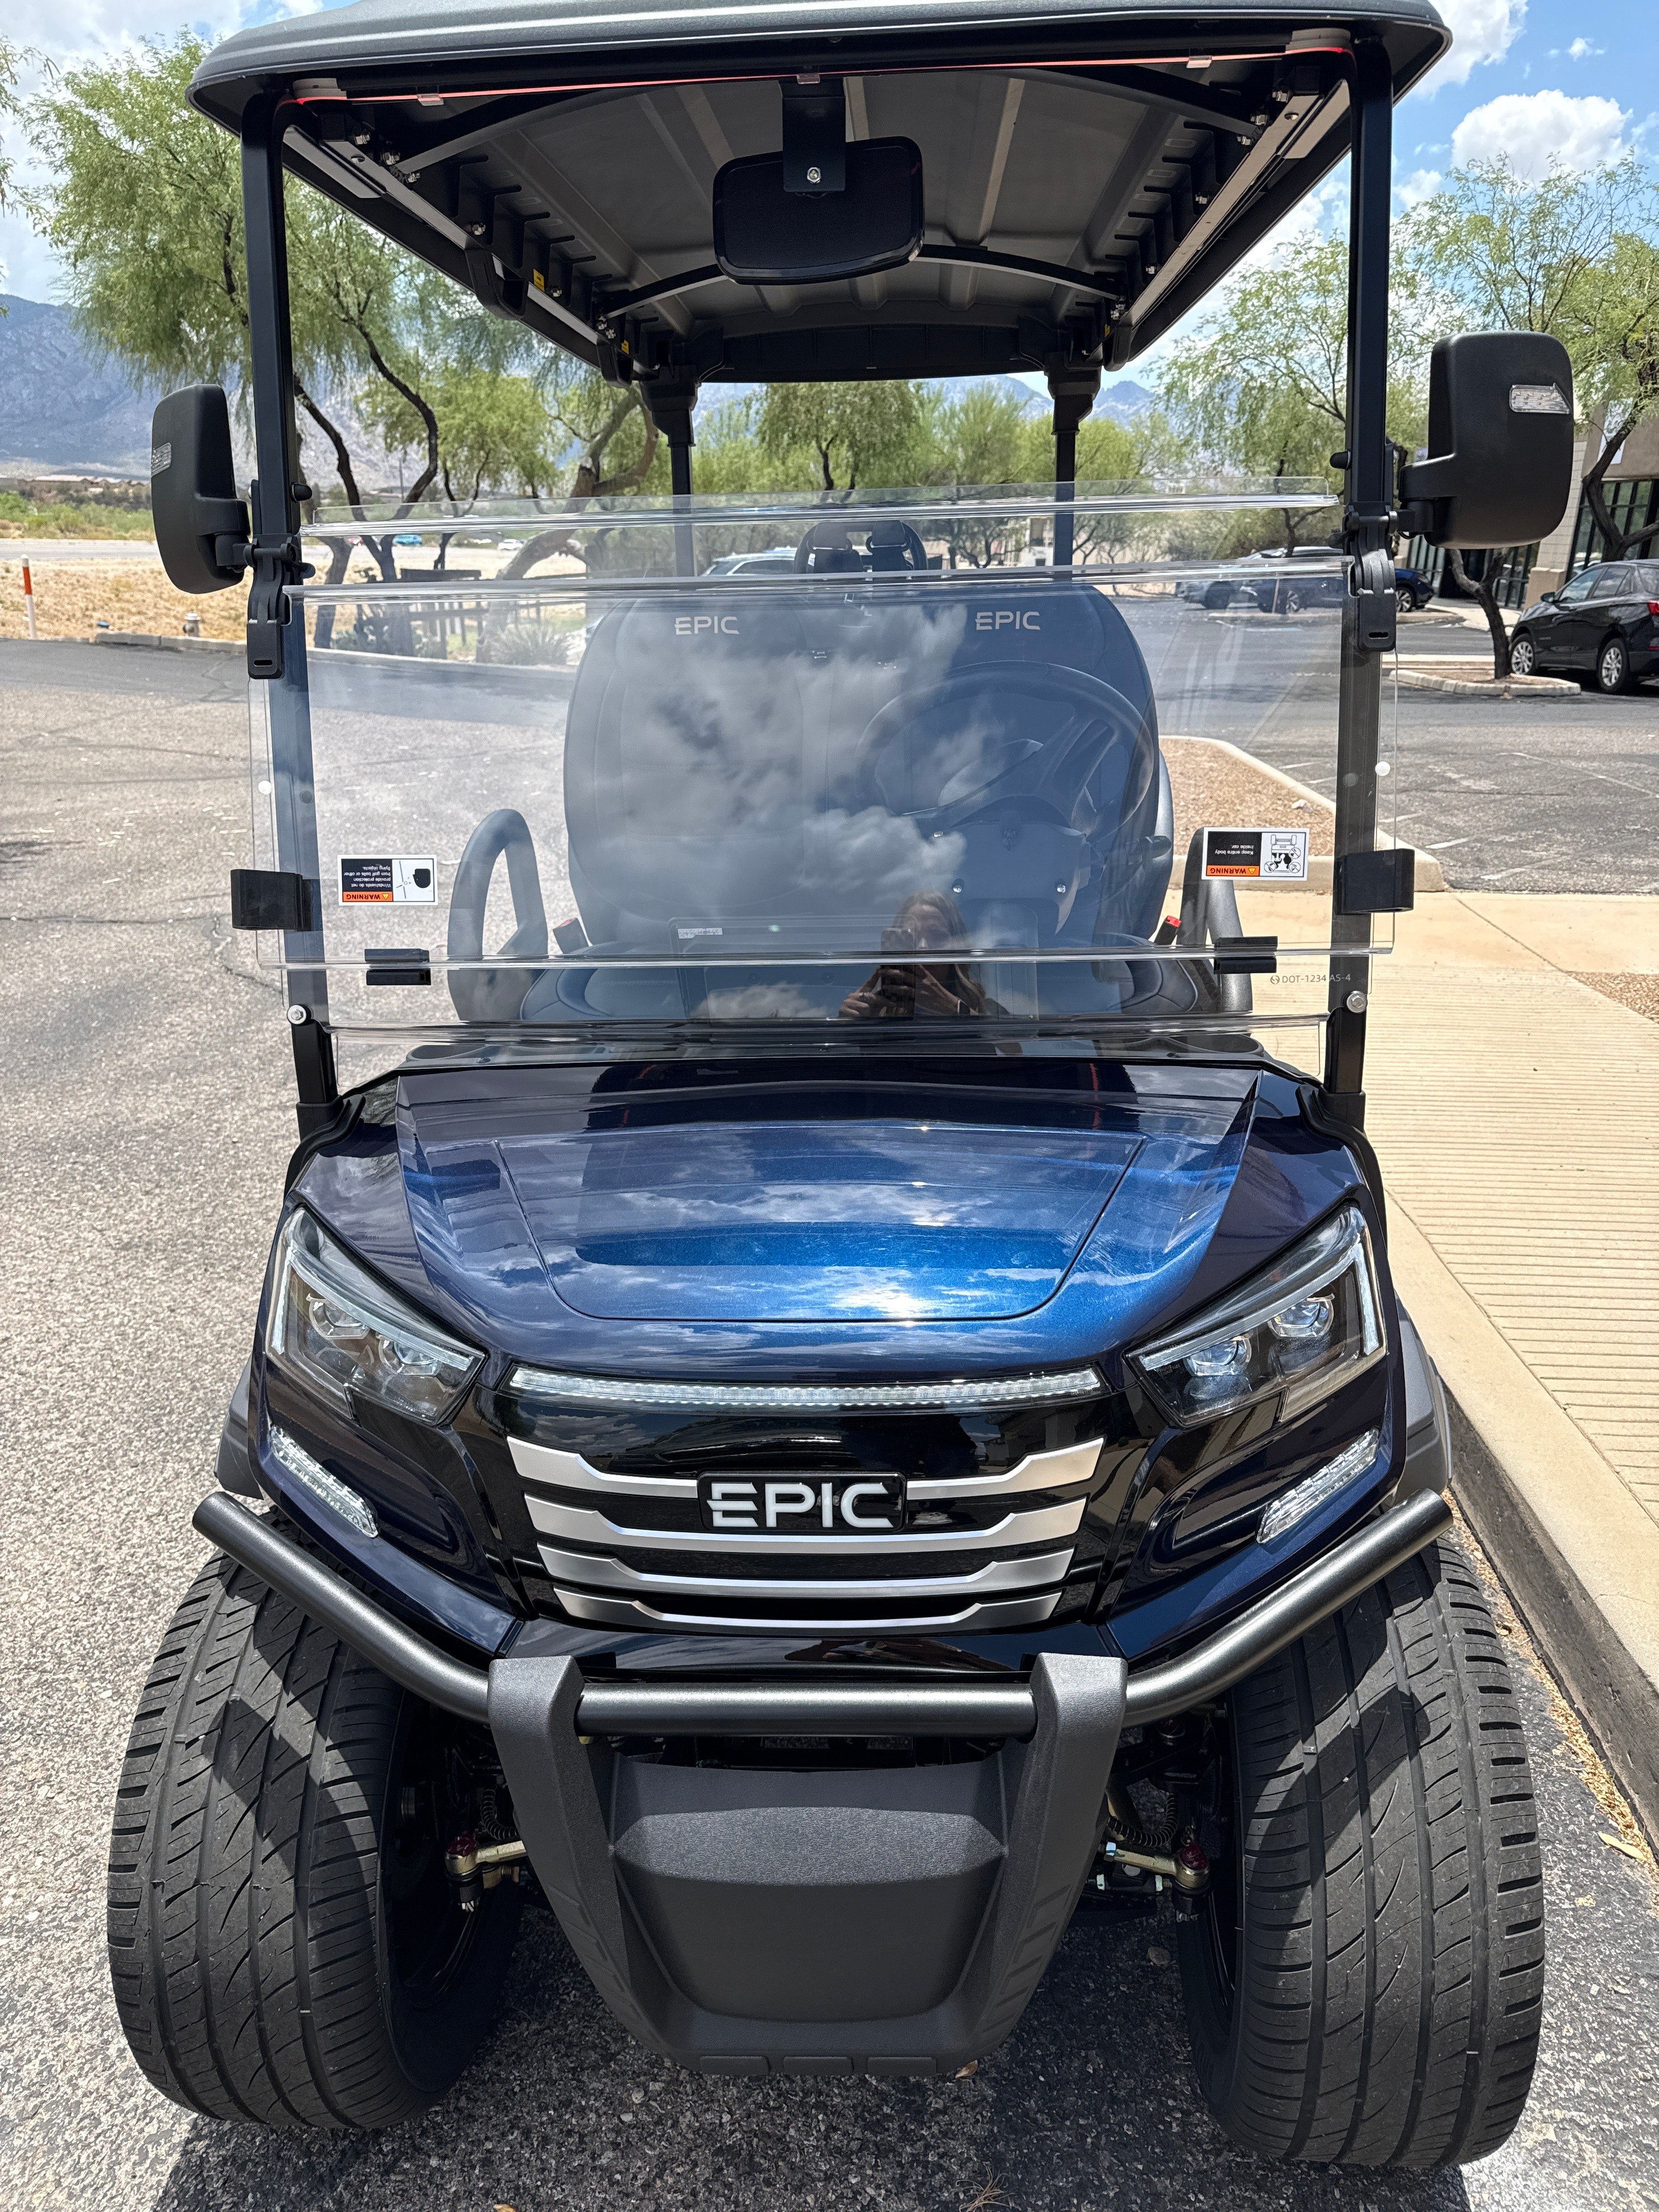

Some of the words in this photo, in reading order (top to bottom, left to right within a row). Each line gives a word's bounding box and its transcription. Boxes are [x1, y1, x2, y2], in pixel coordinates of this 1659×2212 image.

[674, 616, 739, 635] EPIC
[975, 611, 1041, 631] EPIC
[1282, 974, 1327, 983] DOT-1234
[1329, 974, 1351, 982] AS-4
[707, 1482, 894, 1528] EPIC
